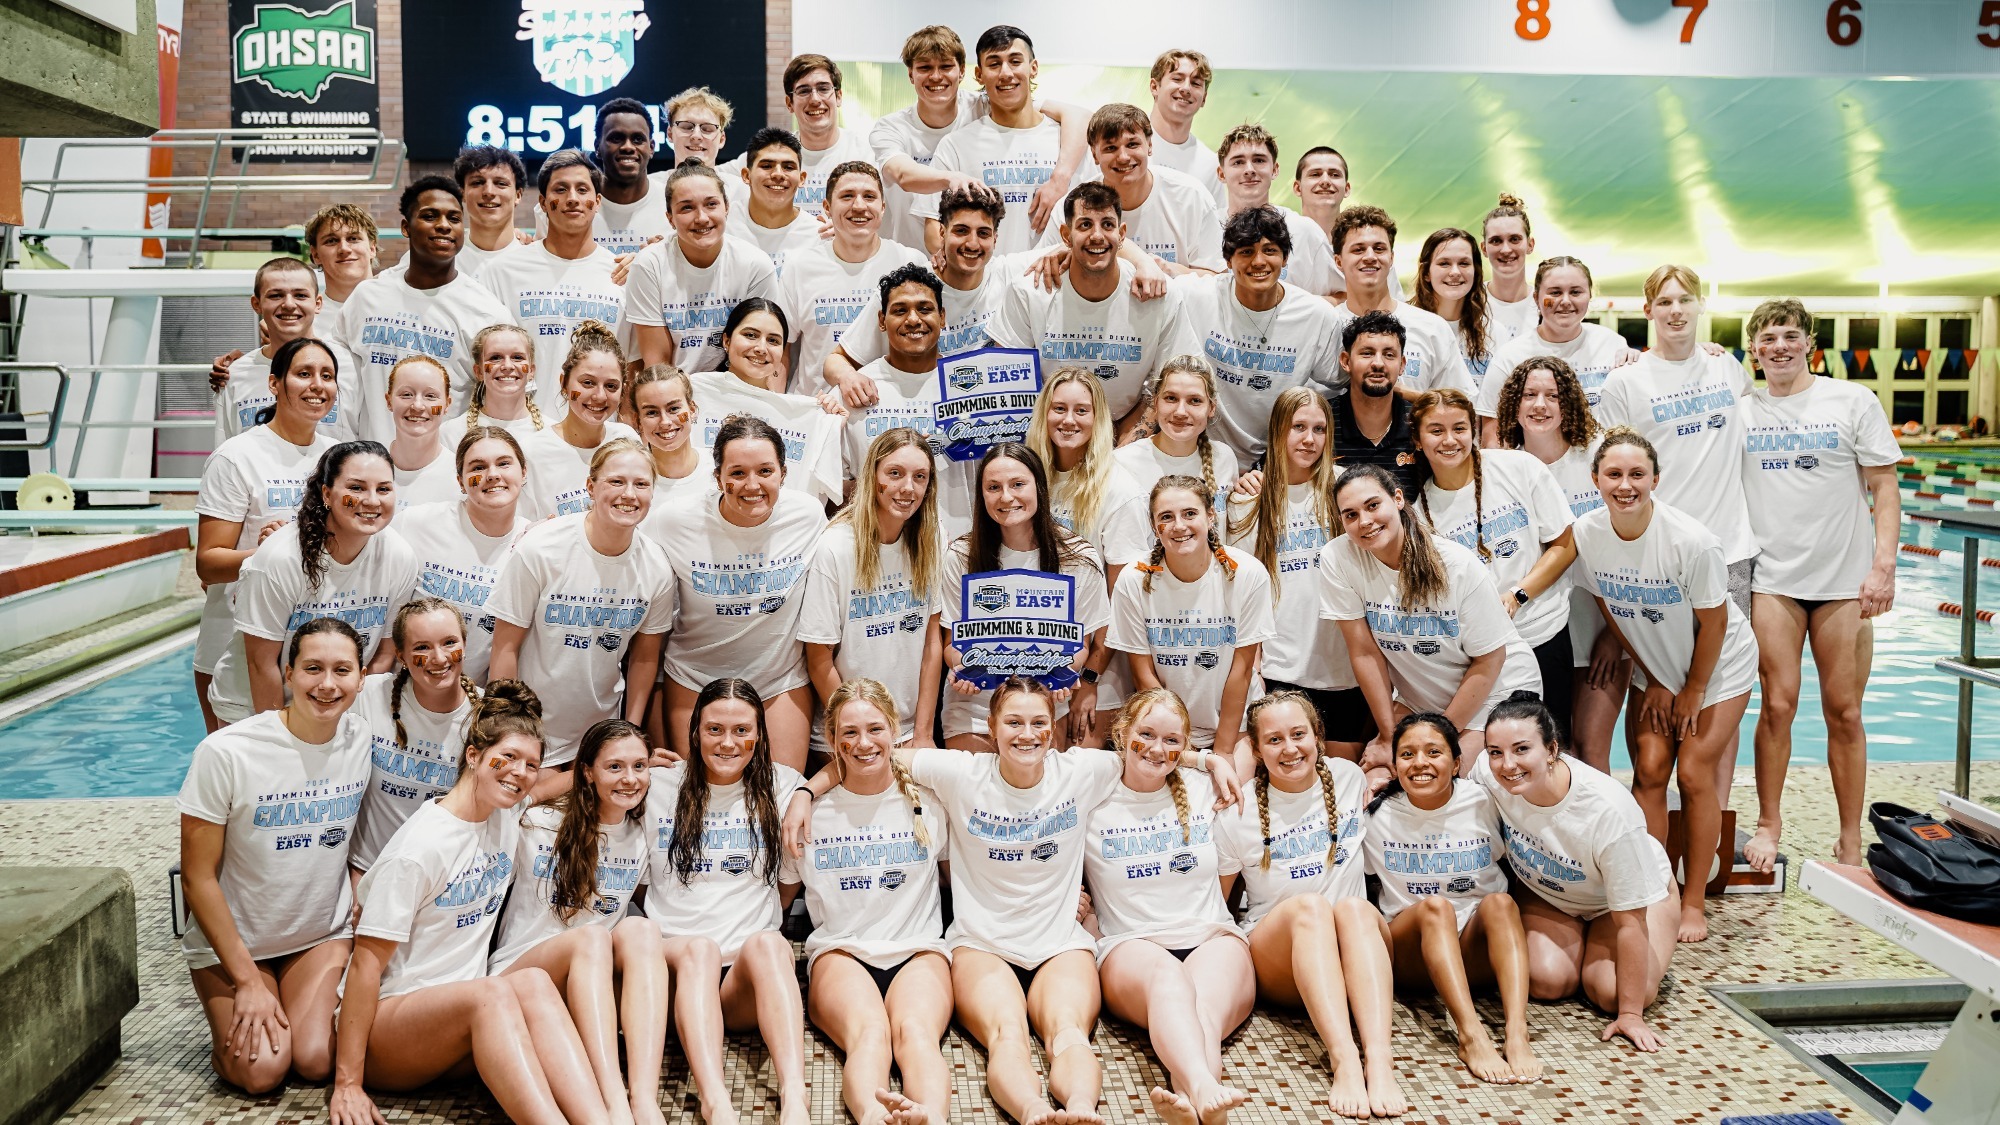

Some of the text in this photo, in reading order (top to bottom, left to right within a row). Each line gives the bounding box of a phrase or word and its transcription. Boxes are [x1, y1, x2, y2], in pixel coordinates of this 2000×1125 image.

[1515, 0, 1551, 41] 8
[1672, 0, 1711, 43] 7
[1826, 0, 1862, 45] 6
[158, 32, 179, 57] TYR
[242, 29, 366, 71] OHSAA
[241, 112, 370, 124] STATE SWIMMING
[587, 293, 620, 304] DIVING
[519, 298, 619, 324] CHAMPIONS
[365, 317, 406, 326] SWIMMING
[422, 325, 455, 338] DIVING
[539, 327, 567, 336] EAST
[362, 325, 454, 358] CHAMPIONS
[680, 338, 703, 348] EAST
[1110, 334, 1142, 342] DIVING
[1210, 331, 1252, 349] SWIMMING
[1042, 340, 1142, 362] CHAMPIONS
[1205, 338, 1296, 373] CHAMPIONS
[371, 355, 397, 366] EAST
[987, 363, 1031, 371] MOUNTAIN
[950, 372, 983, 383] MIDWEST
[988, 368, 1031, 383] EAST
[1216, 371, 1243, 385] EAST
[237, 396, 277, 406] SWIMMI
[1650, 389, 1694, 403] SWIMMING
[938, 395, 1039, 418] SWIMMING & DIVIN
[1652, 389, 1735, 423] CHAMPIONS
[950, 418, 1032, 441] Championsh
[1677, 425, 1701, 436] EAST
[1747, 431, 1838, 452] CHAMPIONS
[1762, 462, 1789, 470] EAST
[1574, 490, 1599, 499] DIVIN
[1492, 502, 1522, 515] DIVING
[425, 561, 483, 582] SWIMMING
[692, 560, 751, 570] SWIMMING
[1280, 561, 1308, 572] EAST
[550, 594, 603, 603] SWIMMING
[975, 594, 1008, 602] MIDWEST
[1016, 596, 1064, 608] EAST
[716, 607, 751, 615] EAST
[1611, 607, 1636, 619] EAST
[866, 621, 895, 637] MOUNTAIN EAST
[957, 621, 1078, 640] SWIMMING & DIVING
[1366, 610, 1459, 637] HAMPIONS
[1147, 625, 1236, 647] HAMPIONS
[962, 648, 1074, 671] Championships
[1157, 657, 1188, 666] EAST
[1015, 668, 1049, 676] Champion
[259, 790, 317, 802] SWIMMING
[336, 781, 364, 793] DIVING
[381, 780, 418, 800] MOUNTAIN EAST
[968, 805, 1077, 842] CHAMPIONS
[1100, 825, 1156, 836] SWIMMING
[276, 839, 311, 850] EAST
[814, 834, 872, 846] SWIMMING
[1383, 841, 1438, 849] SWIMMING
[989, 852, 1023, 861] EAST
[1384, 844, 1491, 874] CHAMPIONS
[1126, 862, 1161, 879] MOUNTAIN EAST
[1290, 861, 1323, 879] MOUNTAIN EAST
[841, 880, 872, 890] EAST
[1408, 885, 1440, 894] EAST
[457, 913, 481, 928] EAST
[1884, 913, 1917, 941] Kiefer
